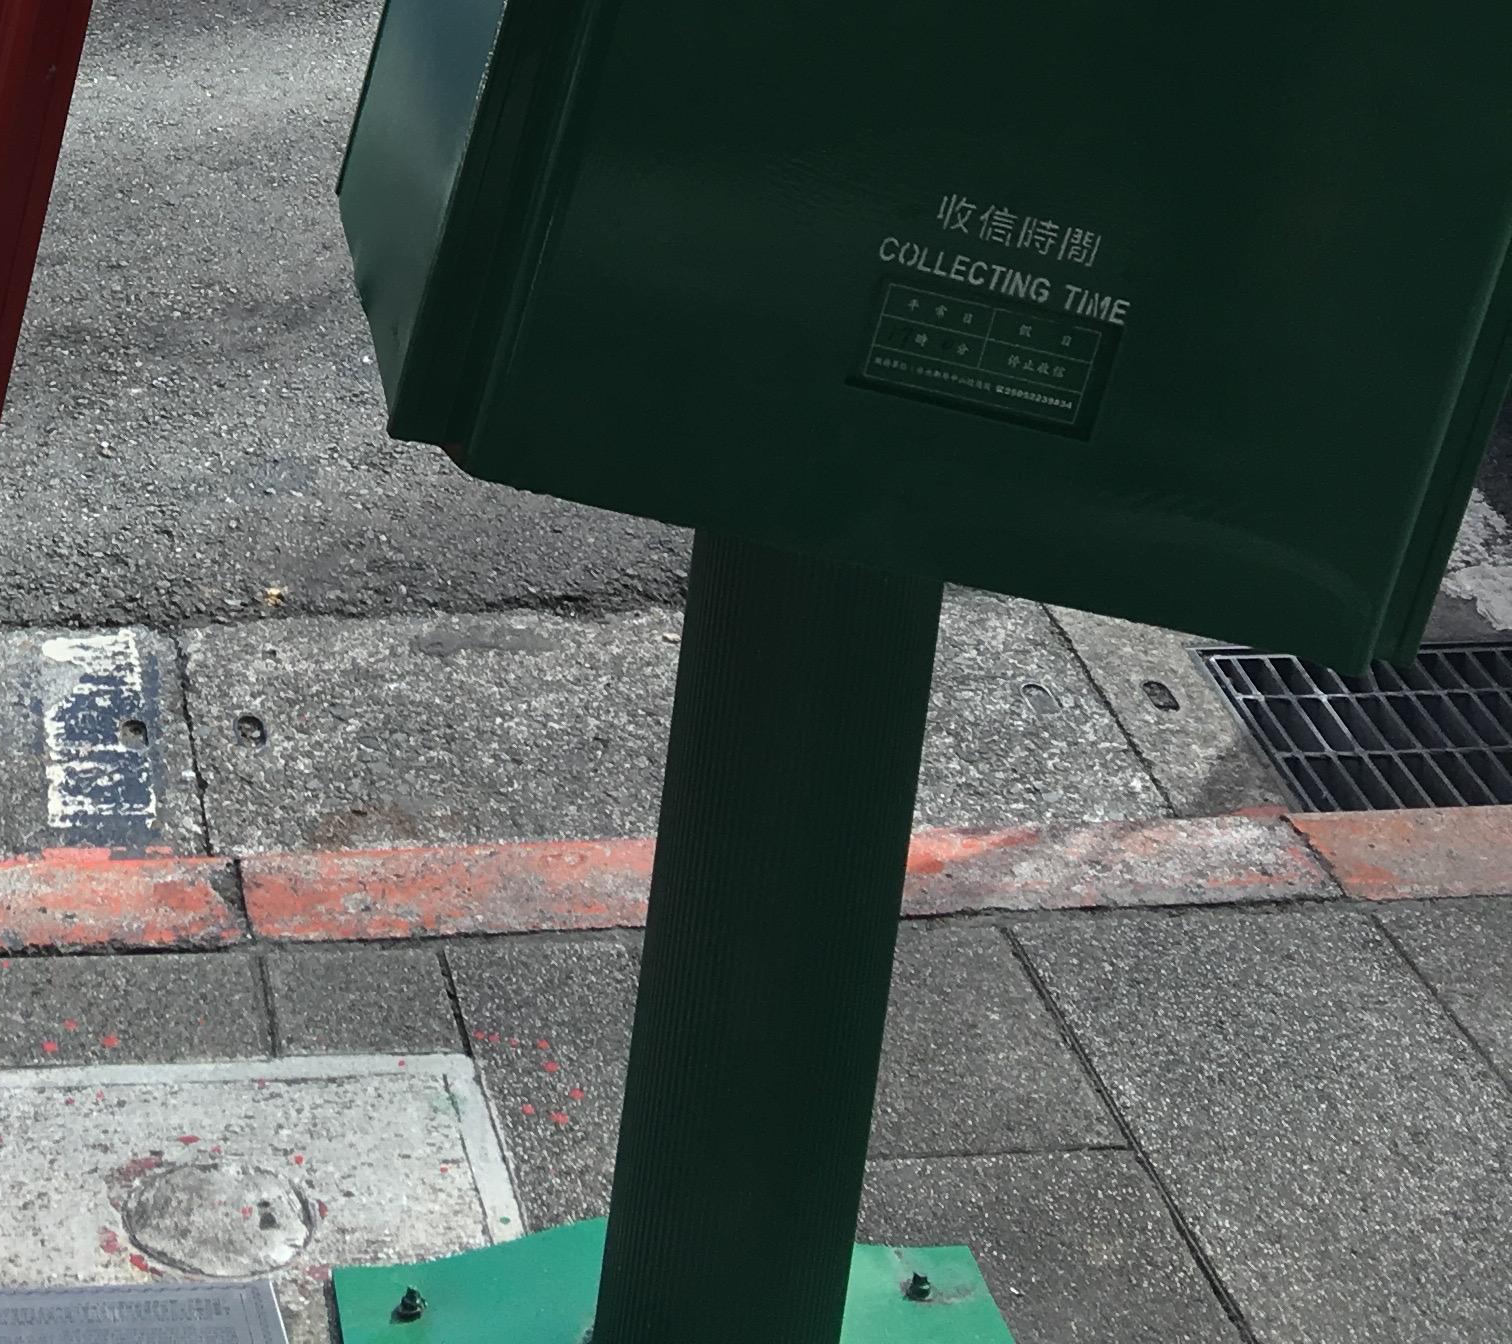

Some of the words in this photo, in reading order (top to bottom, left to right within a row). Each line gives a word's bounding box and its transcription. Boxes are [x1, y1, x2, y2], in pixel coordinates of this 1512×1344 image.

[937, 194, 1102, 267] 收信時間
[878, 236, 1052, 304] COLLECTING
[1063, 283, 1131, 326] TIME
